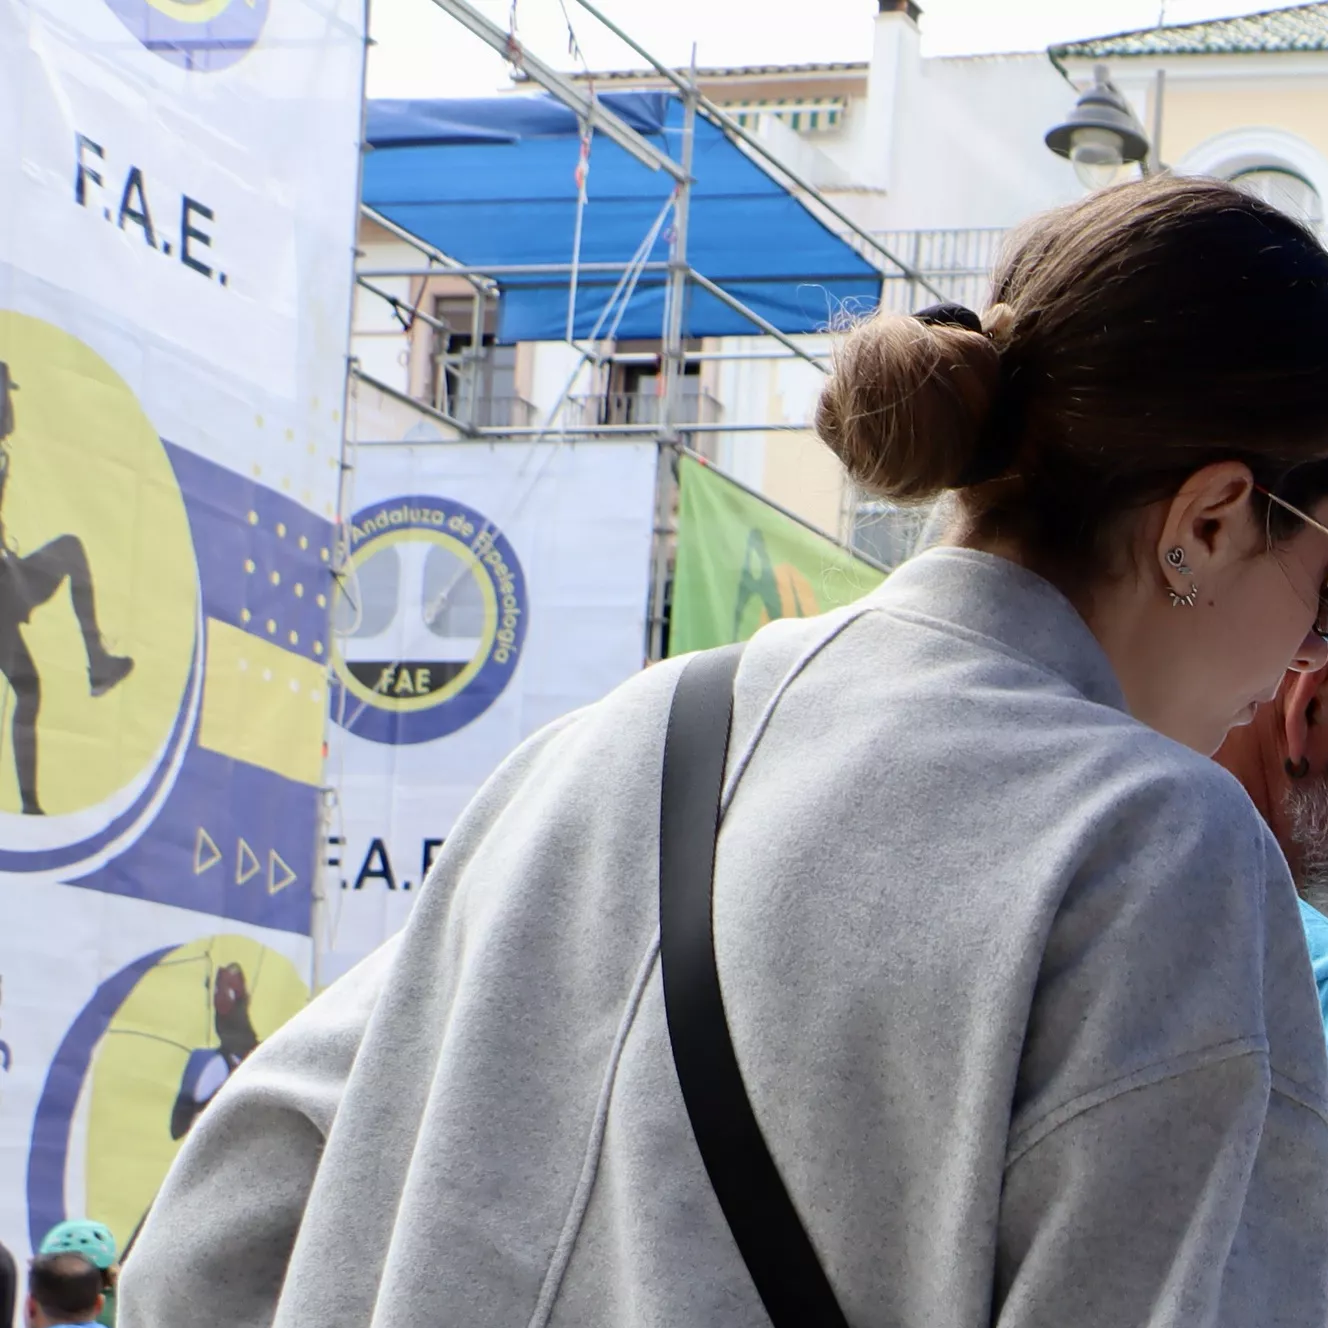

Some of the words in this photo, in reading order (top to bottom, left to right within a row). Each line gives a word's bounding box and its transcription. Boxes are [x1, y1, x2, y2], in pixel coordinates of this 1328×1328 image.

[74, 130, 228, 288] F.A.E.
[351, 504, 446, 544] Andaluza
[446, 514, 475, 537] de
[379, 668, 431, 694] FAE
